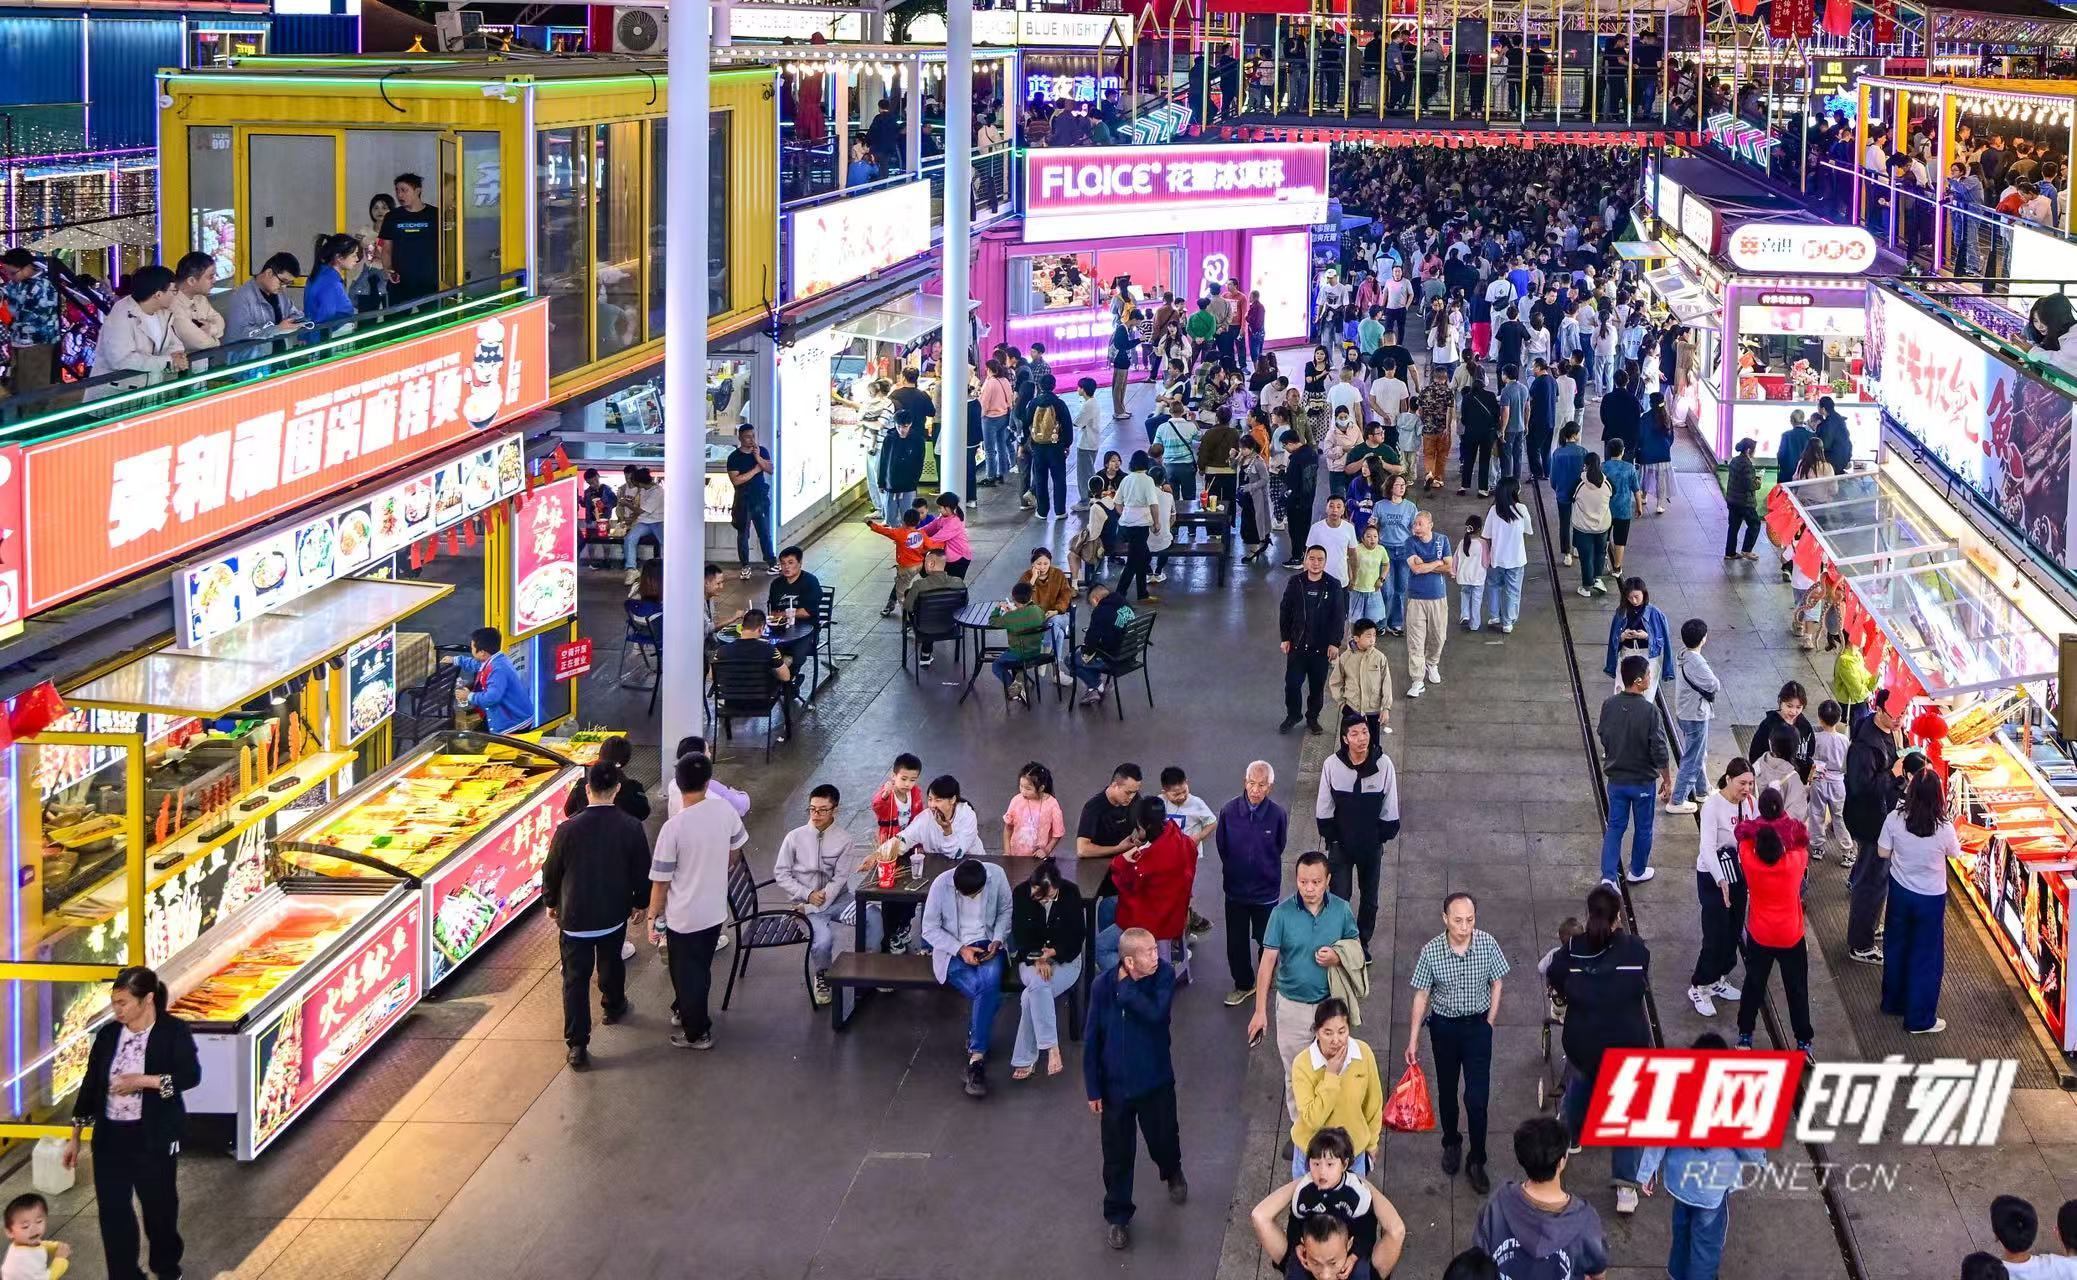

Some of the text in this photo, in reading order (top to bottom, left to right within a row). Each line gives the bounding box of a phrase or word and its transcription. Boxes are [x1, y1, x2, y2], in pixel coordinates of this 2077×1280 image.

[1026, 21, 1058, 36] BLUE
[1062, 22, 1100, 37] NIGHT
[560, 655, 587, 671] 正在营业
